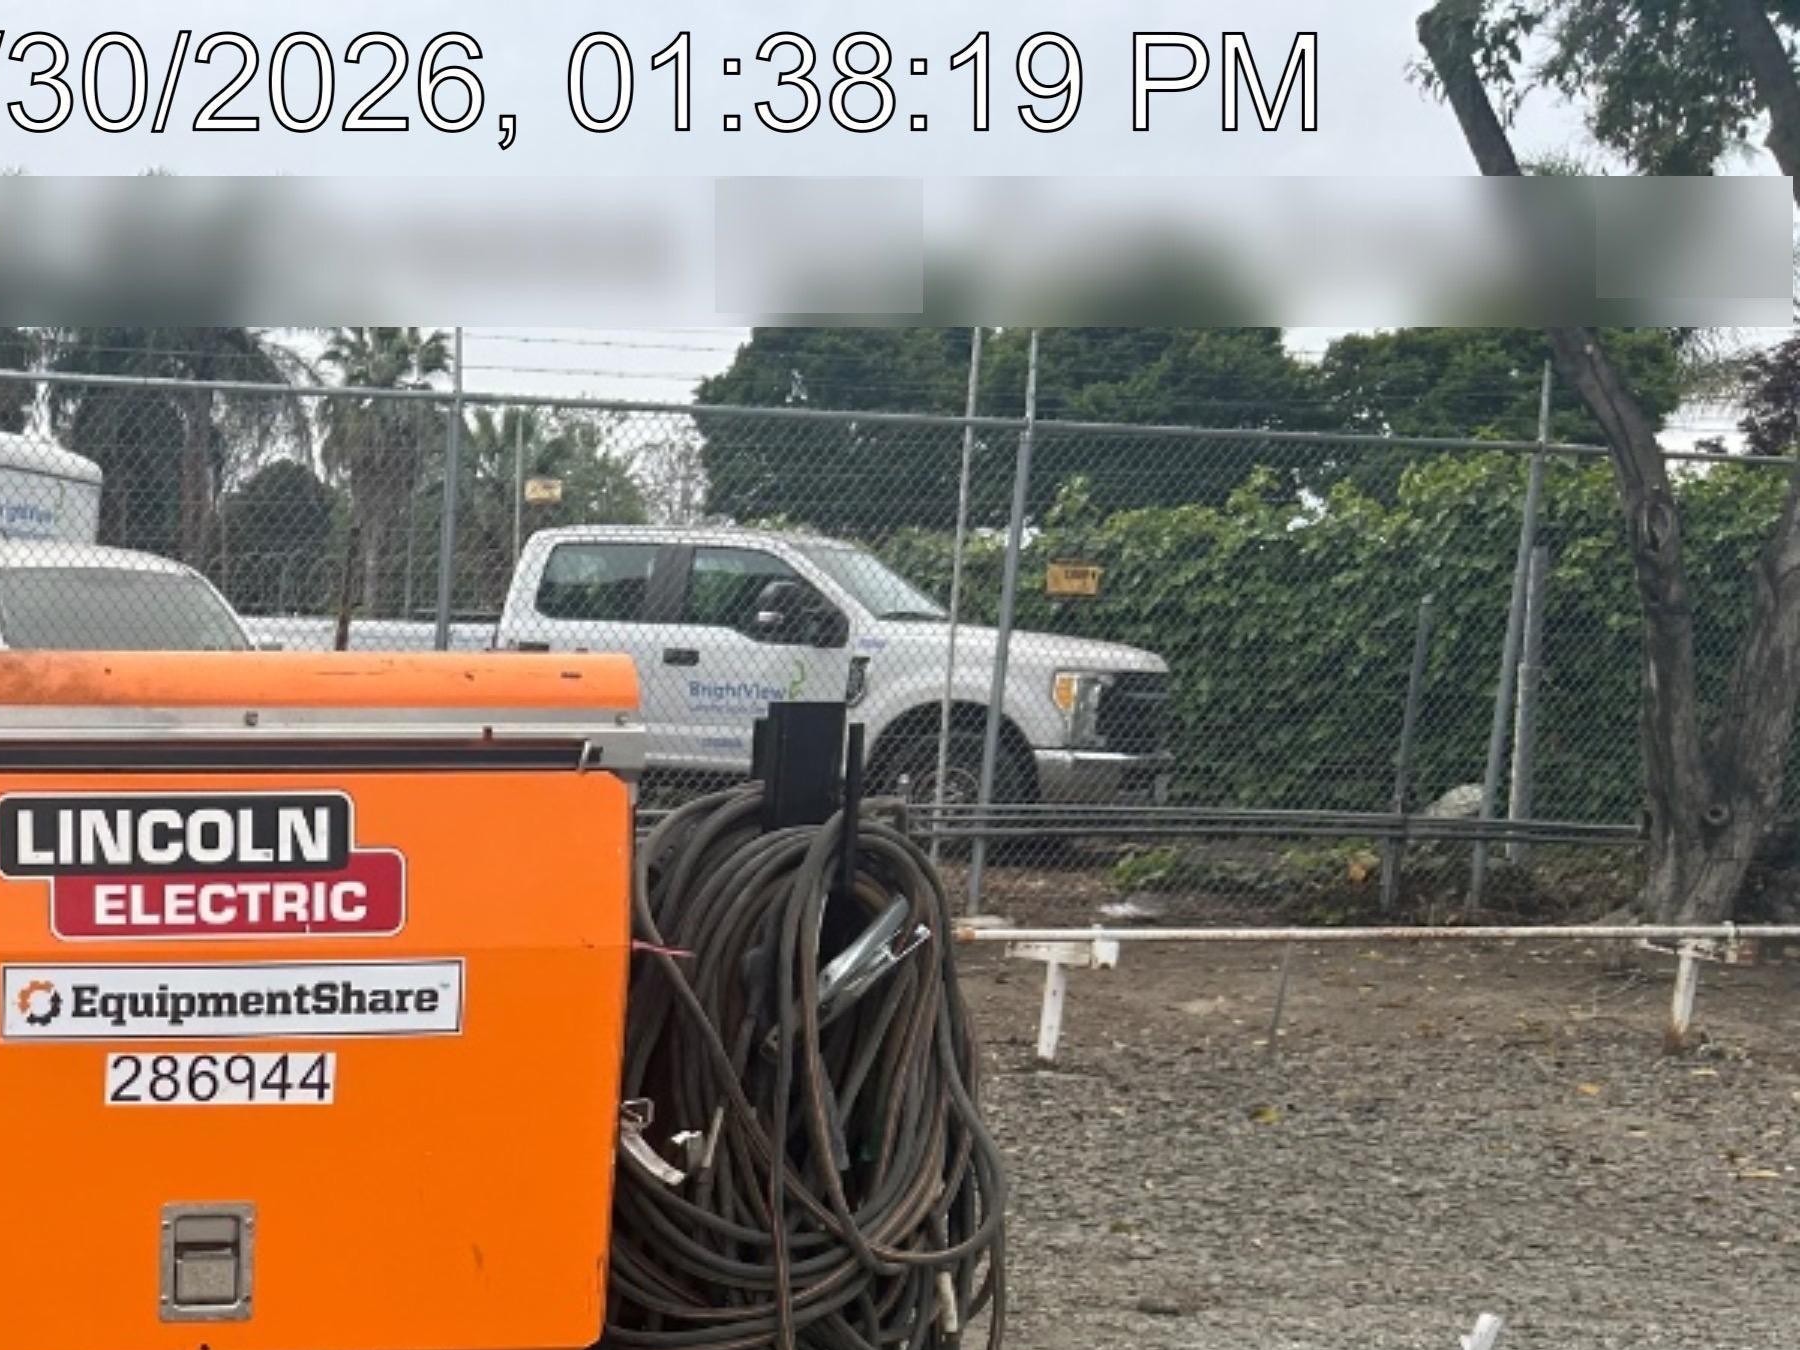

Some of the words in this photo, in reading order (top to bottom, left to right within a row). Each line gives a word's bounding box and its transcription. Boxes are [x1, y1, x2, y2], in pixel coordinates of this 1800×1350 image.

[689, 680, 786, 700] BrightView
[17, 807, 330, 865] LINCOLN
[94, 881, 368, 925] ELECTRIC
[71, 981, 440, 1026] EquipmentShare
[109, 1053, 331, 1102] 286944
